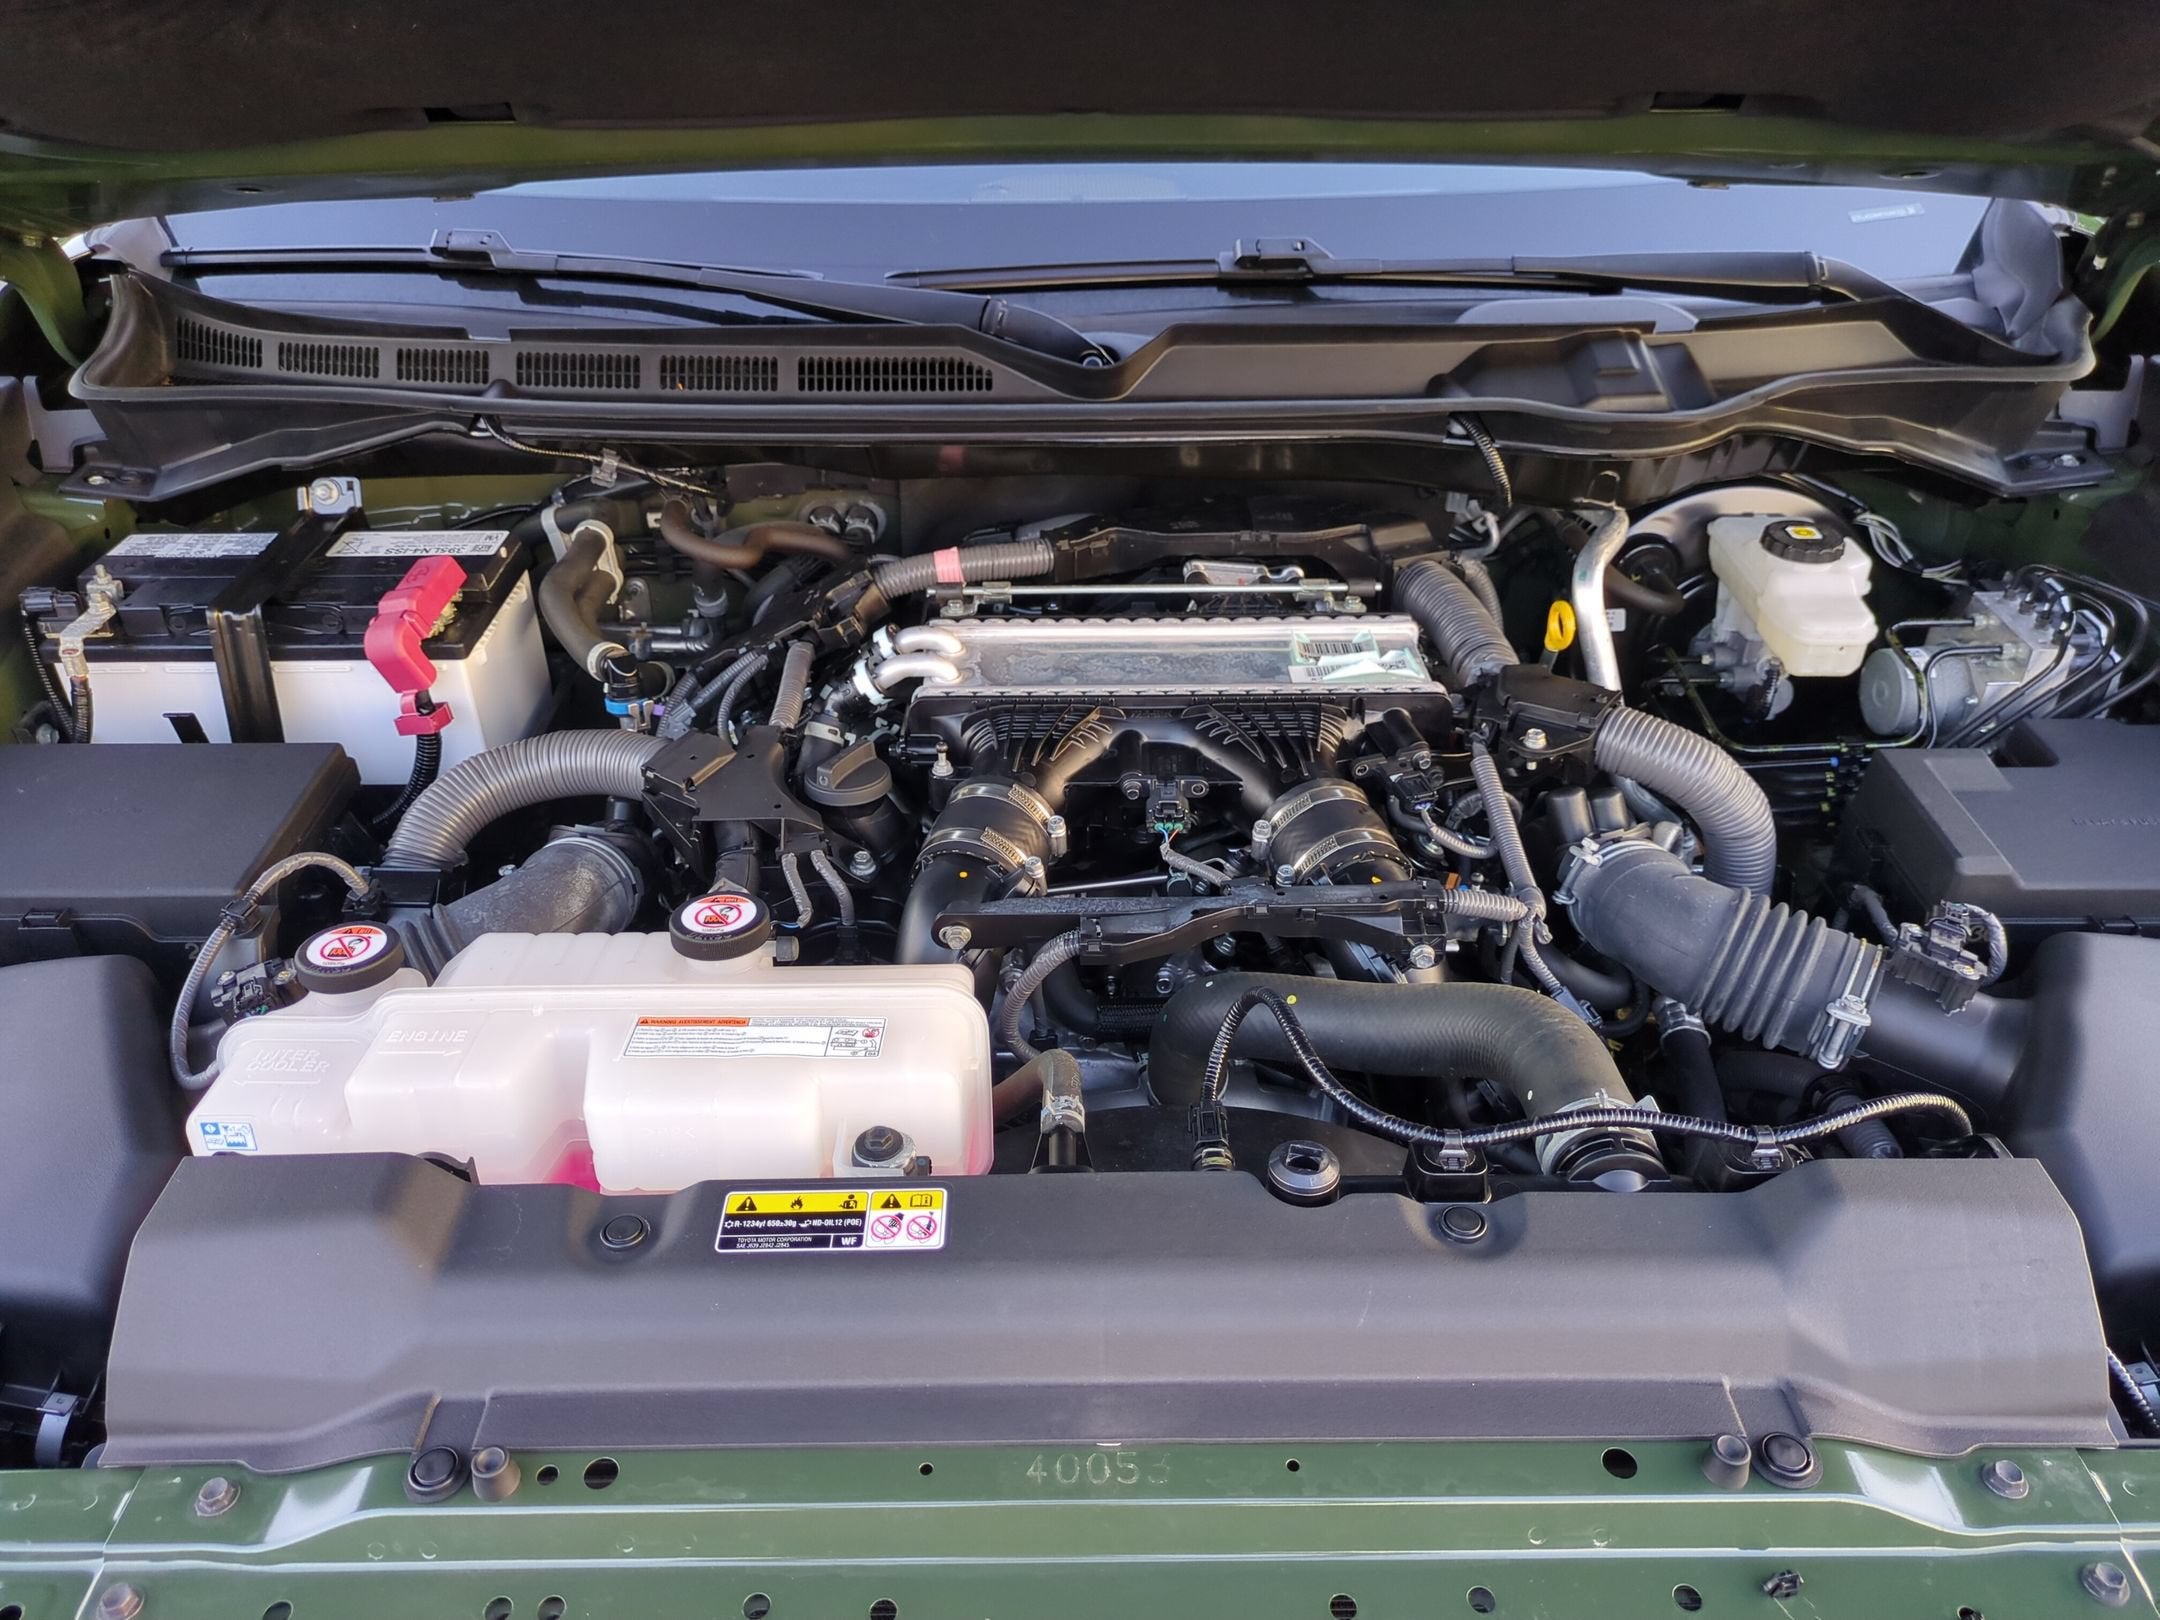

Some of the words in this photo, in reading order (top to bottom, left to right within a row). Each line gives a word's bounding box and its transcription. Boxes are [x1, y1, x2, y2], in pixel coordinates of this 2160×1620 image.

[385, 1030, 469, 1043] ENGINE
[252, 1048, 322, 1061] INTER
[246, 1060, 331, 1073] COOLER
[843, 1217, 862, 1227] (POE)
[776, 1235, 812, 1243] CORPORATION
[841, 1236, 858, 1246] WF
